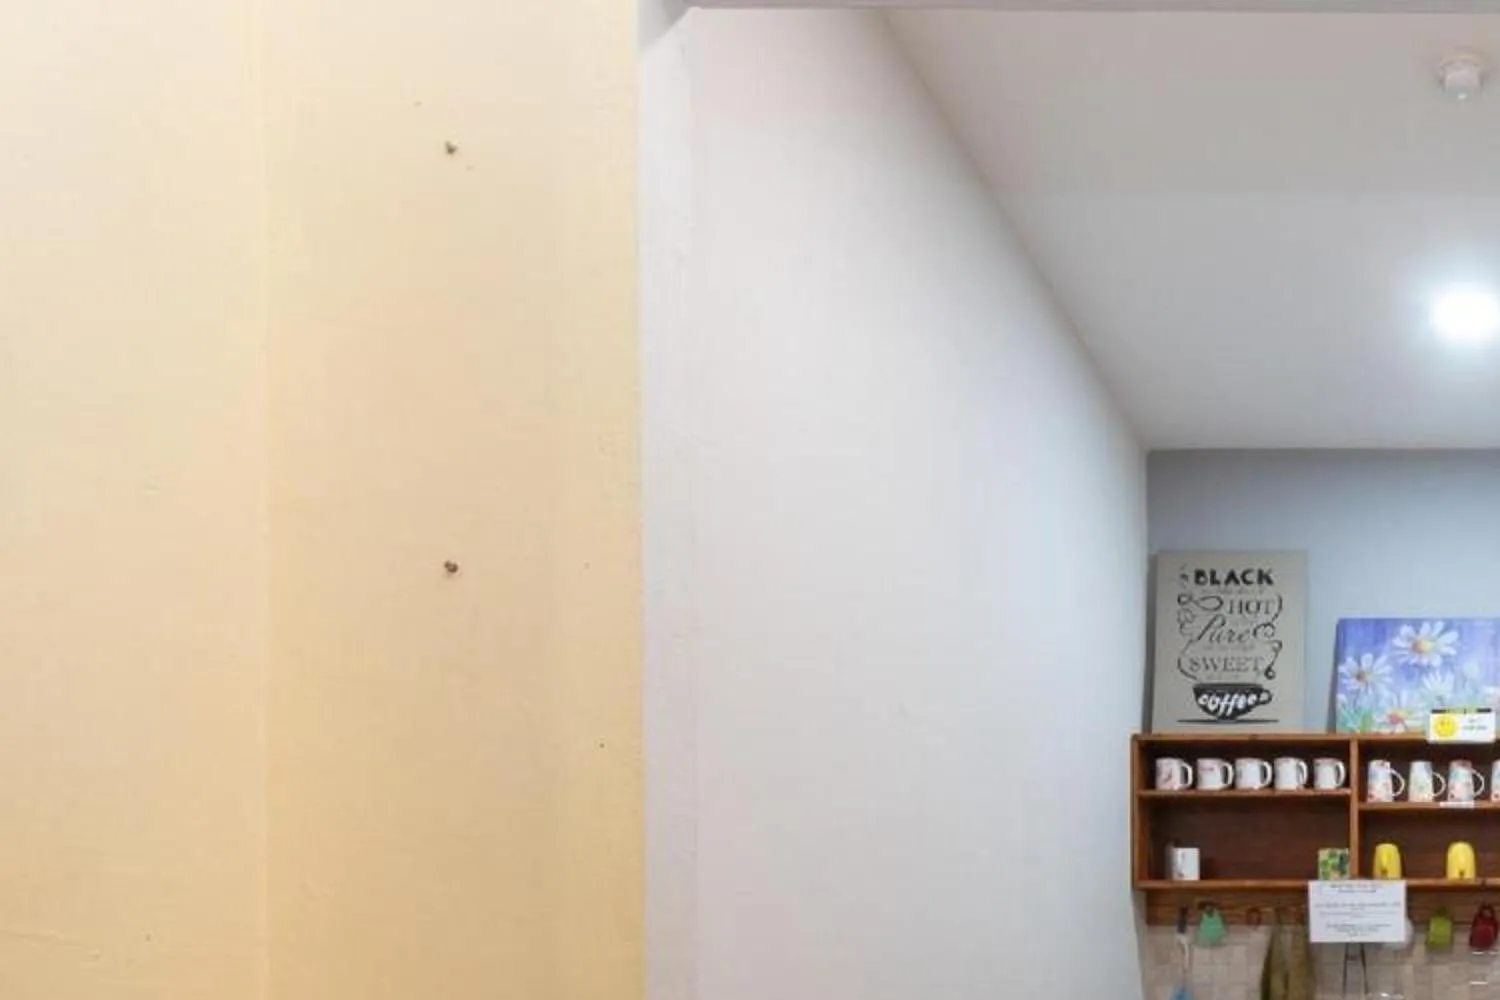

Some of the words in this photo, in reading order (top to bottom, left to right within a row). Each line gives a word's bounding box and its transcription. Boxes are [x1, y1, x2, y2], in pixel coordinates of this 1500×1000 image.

[1194, 568, 1274, 586] BLACK
[1227, 598, 1276, 616] HOT
[1188, 655, 1264, 673] SWEET
[1197, 693, 1258, 717] coffee
